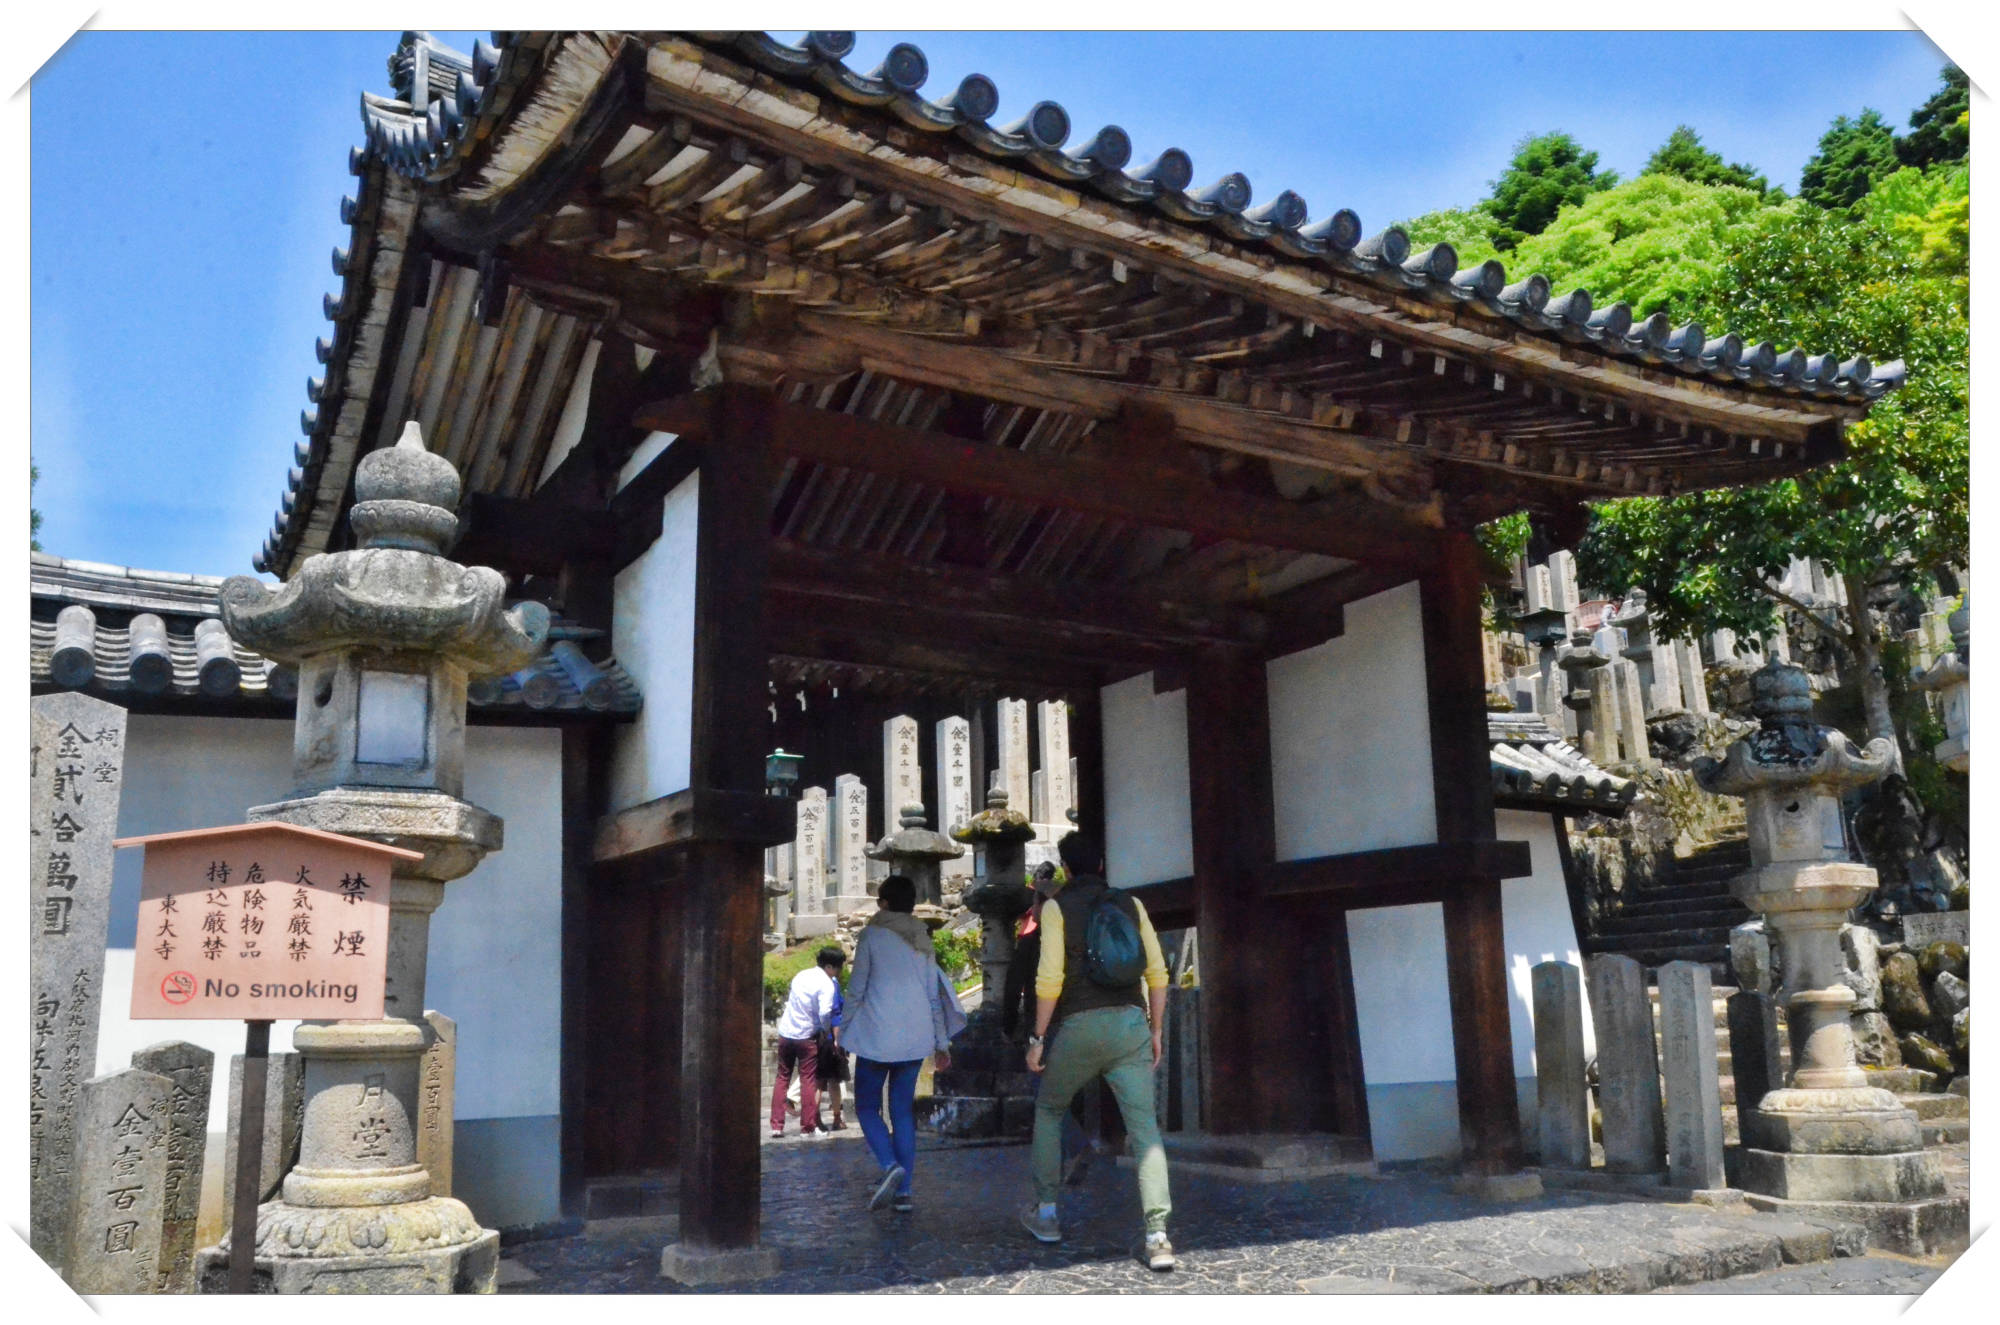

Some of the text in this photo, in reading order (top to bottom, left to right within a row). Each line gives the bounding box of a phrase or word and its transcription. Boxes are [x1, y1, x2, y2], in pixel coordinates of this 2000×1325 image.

[93, 727, 119, 783] 祠堂
[154, 893, 179, 960] 東大寺
[201, 861, 233, 961] 持込厳禁
[239, 862, 267, 959] 危険物品
[287, 865, 314, 962] 火気厳禁
[332, 871, 371, 957] 禁煙
[204, 978, 358, 1003] No smoking
